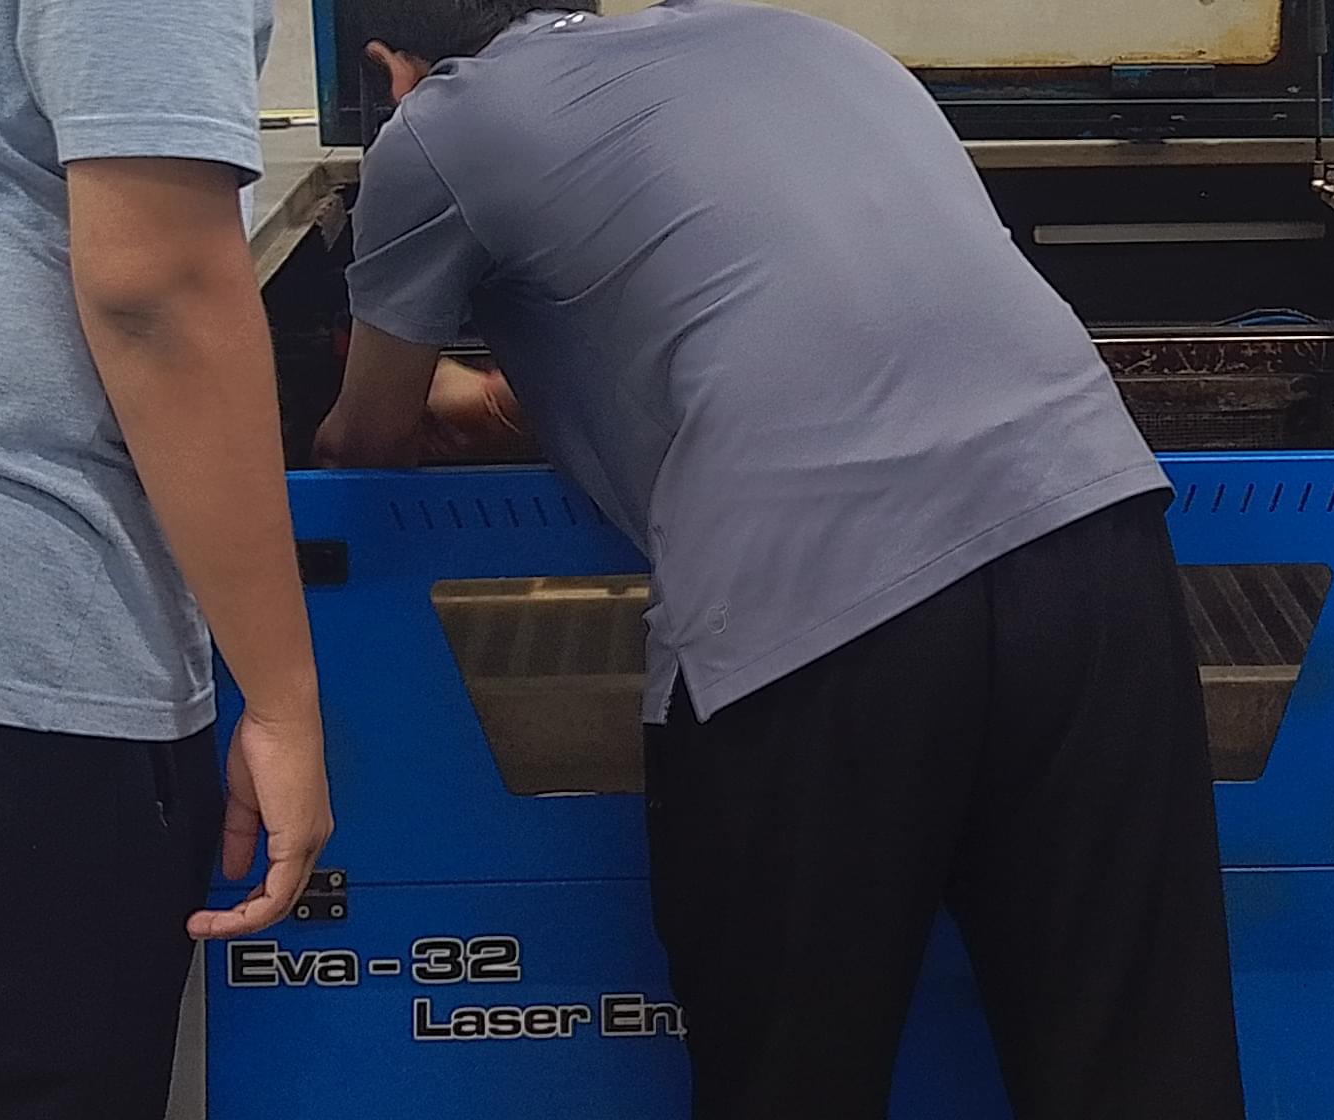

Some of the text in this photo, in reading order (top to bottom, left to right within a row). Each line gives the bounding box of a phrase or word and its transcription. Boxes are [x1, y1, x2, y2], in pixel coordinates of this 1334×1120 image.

[228, 940, 359, 987] Eva
[411, 936, 521, 984] 32
[413, 993, 687, 1040] Laser En
